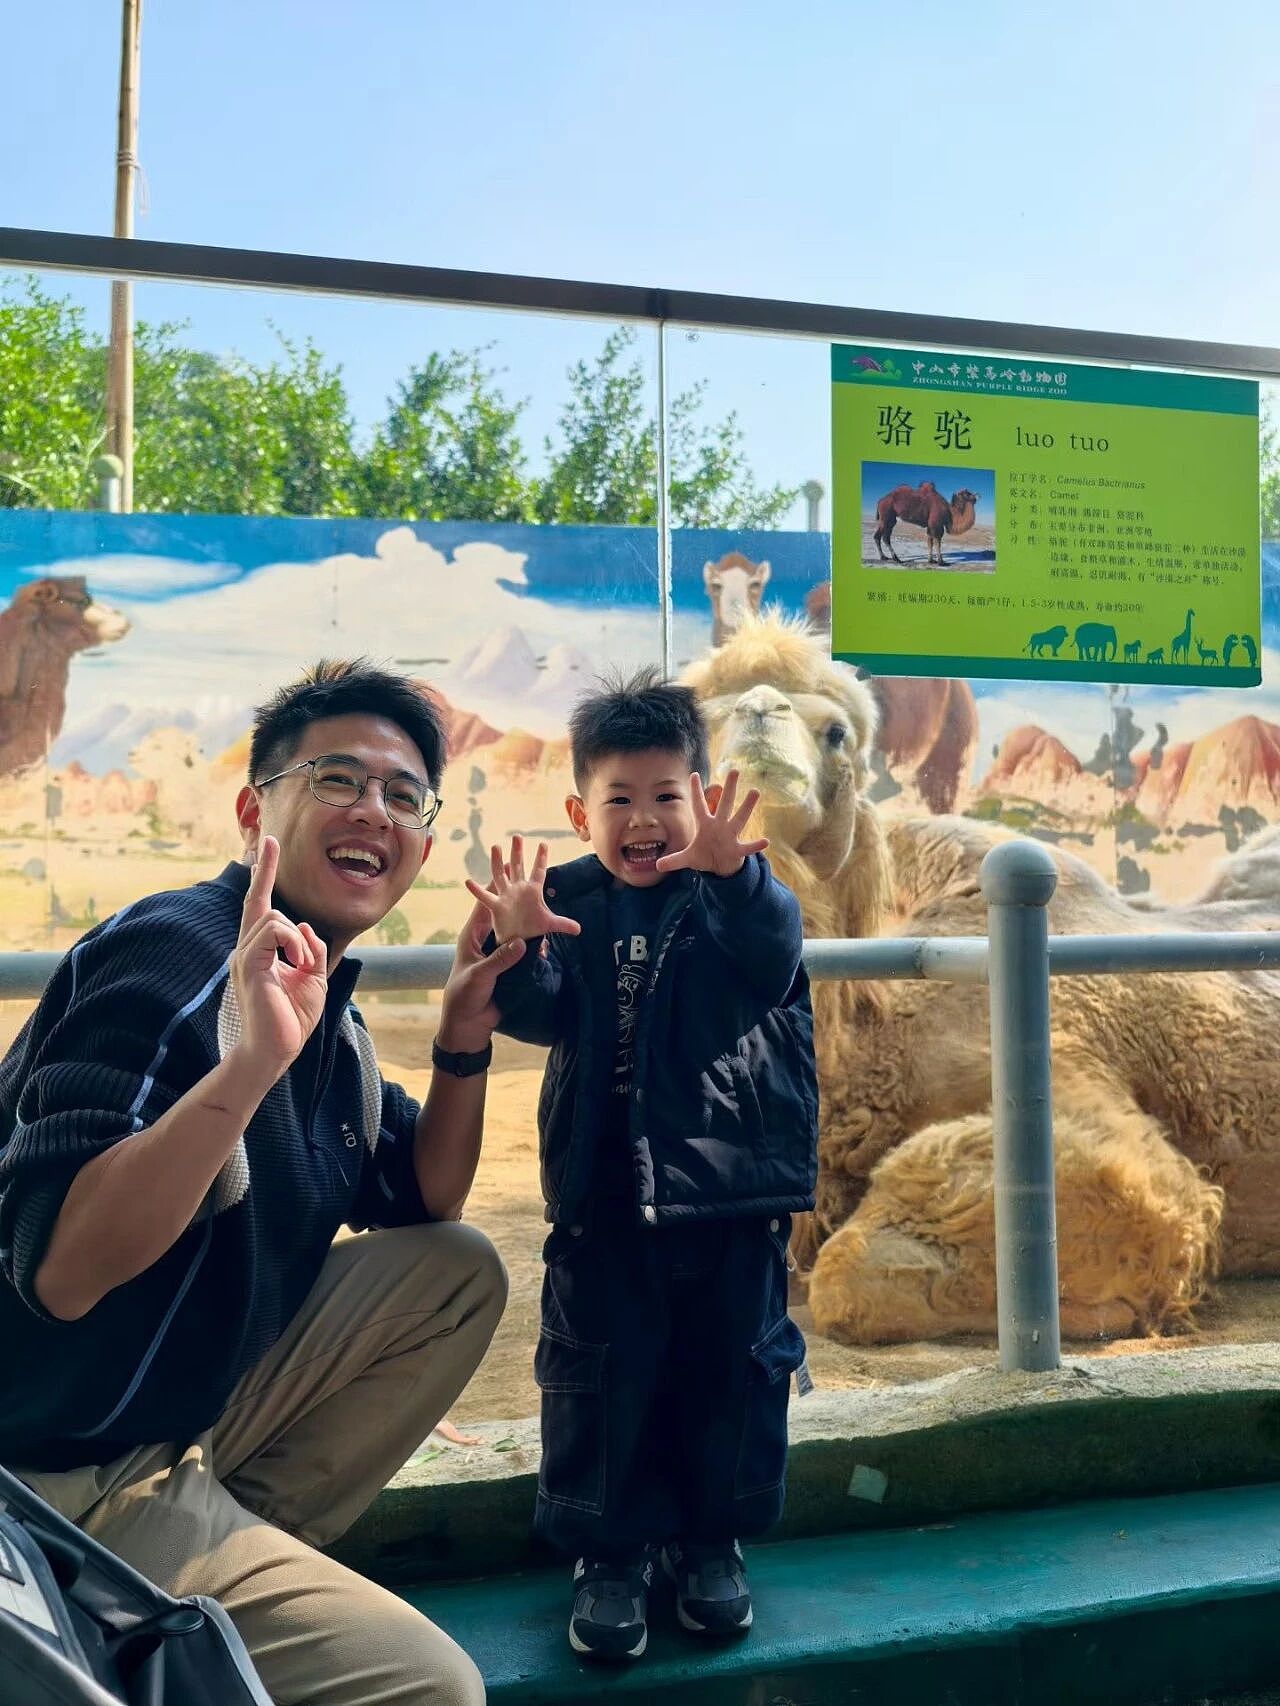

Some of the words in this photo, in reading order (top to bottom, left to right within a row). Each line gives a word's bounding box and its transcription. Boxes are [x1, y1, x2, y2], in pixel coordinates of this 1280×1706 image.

[912, 376, 972, 388] ZHONGSHAN
[976, 381, 1012, 391] PURPLE
[1016, 384, 1045, 394] RIDGE
[1048, 387, 1068, 395] ZOO
[1015, 427, 1054, 448] luo
[1069, 432, 1109, 452] tuo
[1056, 475, 1095, 487] Camelus
[1098, 478, 1145, 490] Bactrianus
